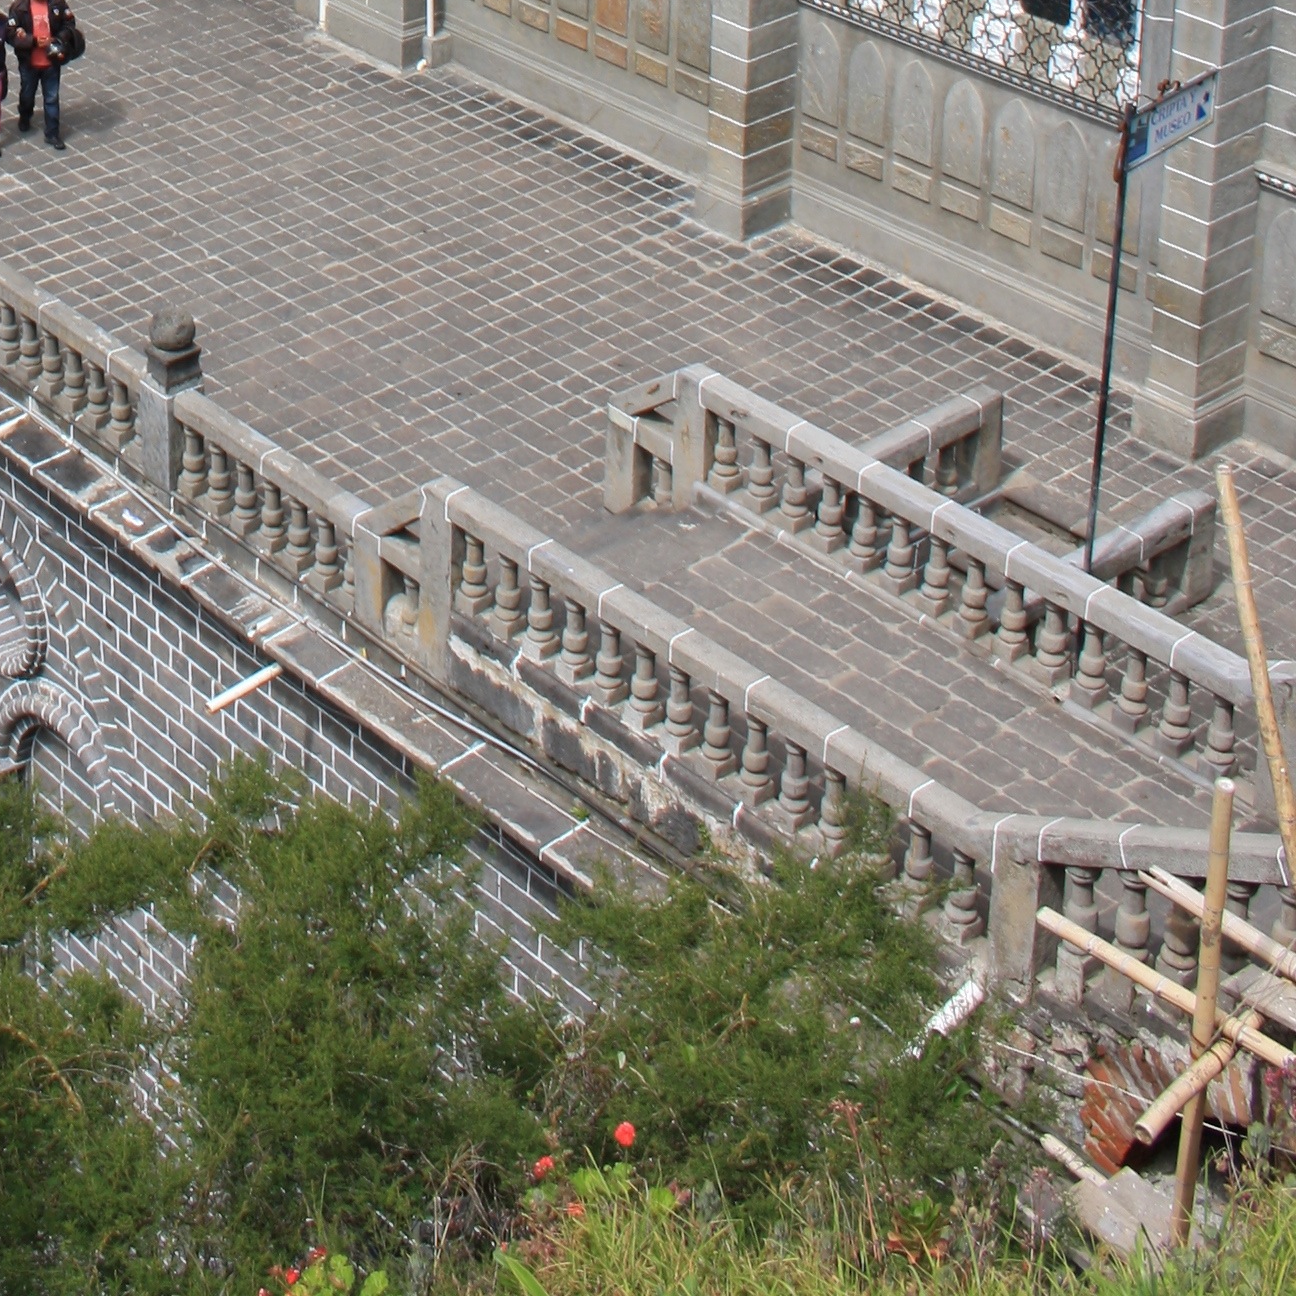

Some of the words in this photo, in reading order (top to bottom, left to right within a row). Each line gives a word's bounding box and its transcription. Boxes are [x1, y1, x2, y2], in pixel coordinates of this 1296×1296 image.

[1150, 96, 1187, 126] CRIPTA
[1190, 88, 1197, 103] Y
[1154, 111, 1191, 143] MUSEO
